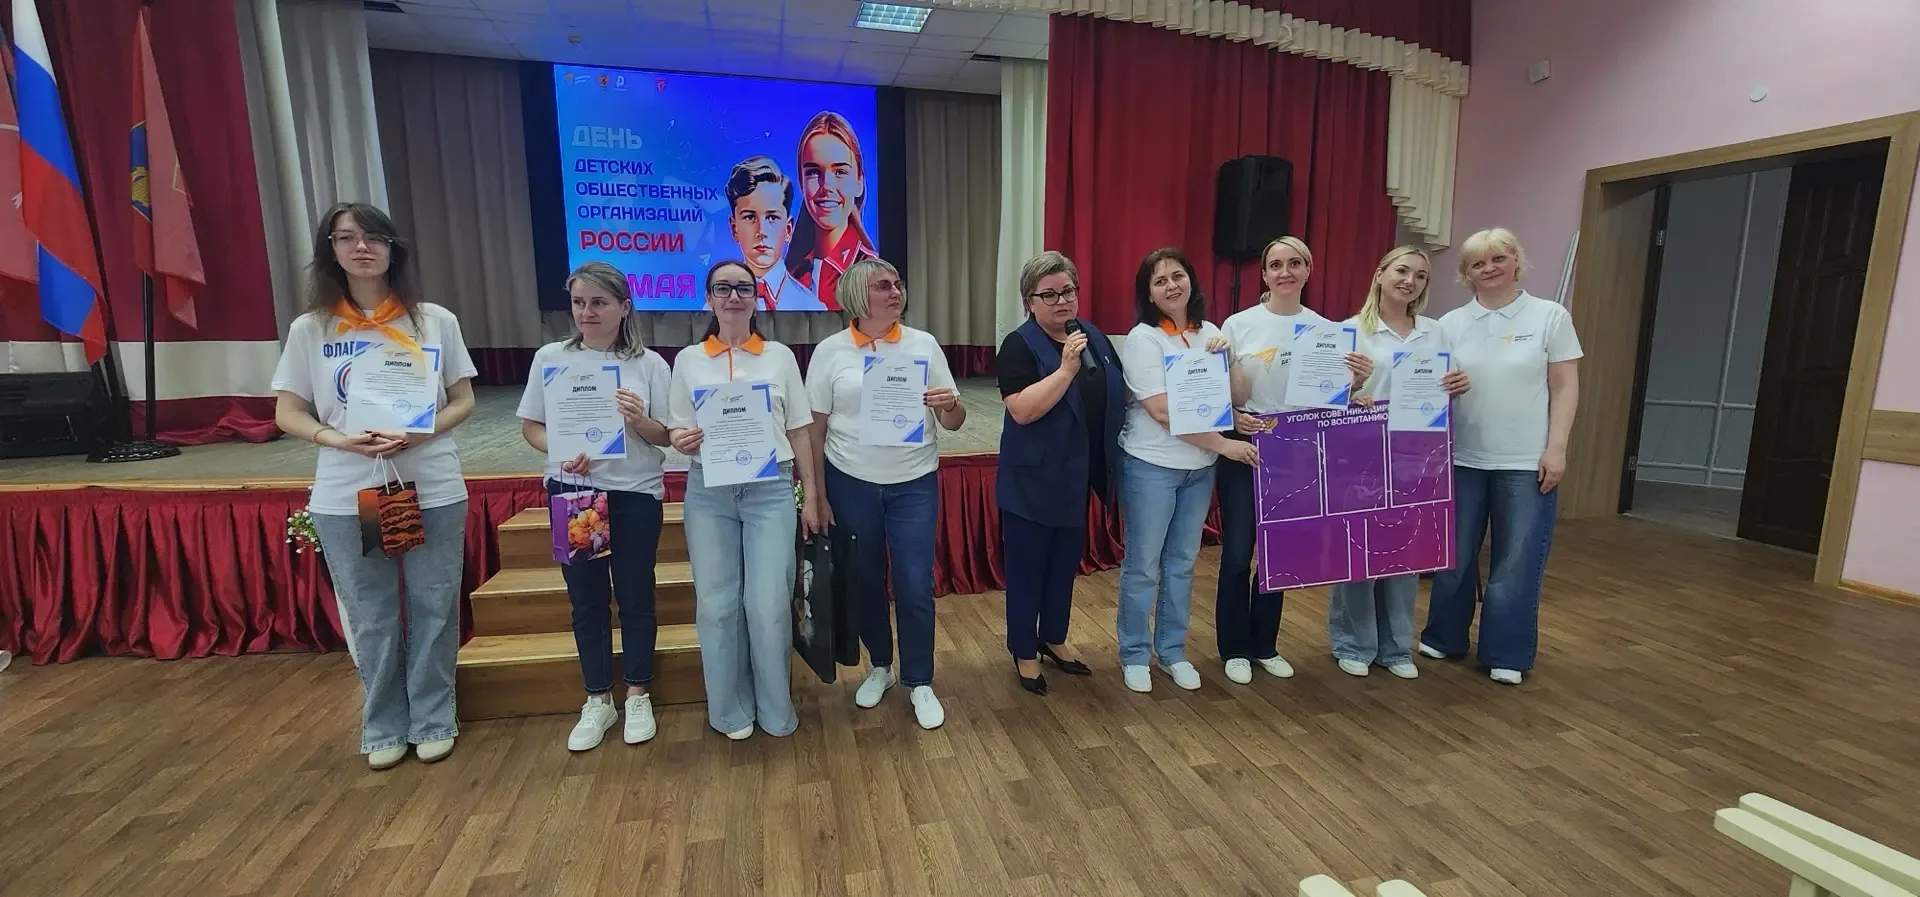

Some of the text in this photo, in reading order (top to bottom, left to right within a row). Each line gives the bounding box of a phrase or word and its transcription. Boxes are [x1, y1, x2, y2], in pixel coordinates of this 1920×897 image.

[571, 124, 643, 150] ДЕНЬ
[574, 159, 654, 175] ДЕТСКИХ
[576, 182, 719, 201] ОБЩЕСТВЕННЫХ
[577, 205, 703, 223] ОРГАНИЗАЦИЙ
[579, 230, 684, 252] РОССИИ
[628, 273, 696, 299] МАЯ
[1187, 367, 1208, 375] ДИПЛОМ
[722, 406, 747, 415] ДИПЛОМ
[1286, 412, 1320, 423] УГОЛОК
[1320, 407, 1369, 419] СОВЕТНИКА
[1317, 413, 1388, 428] ПО ВОСПИТАНИЮ
